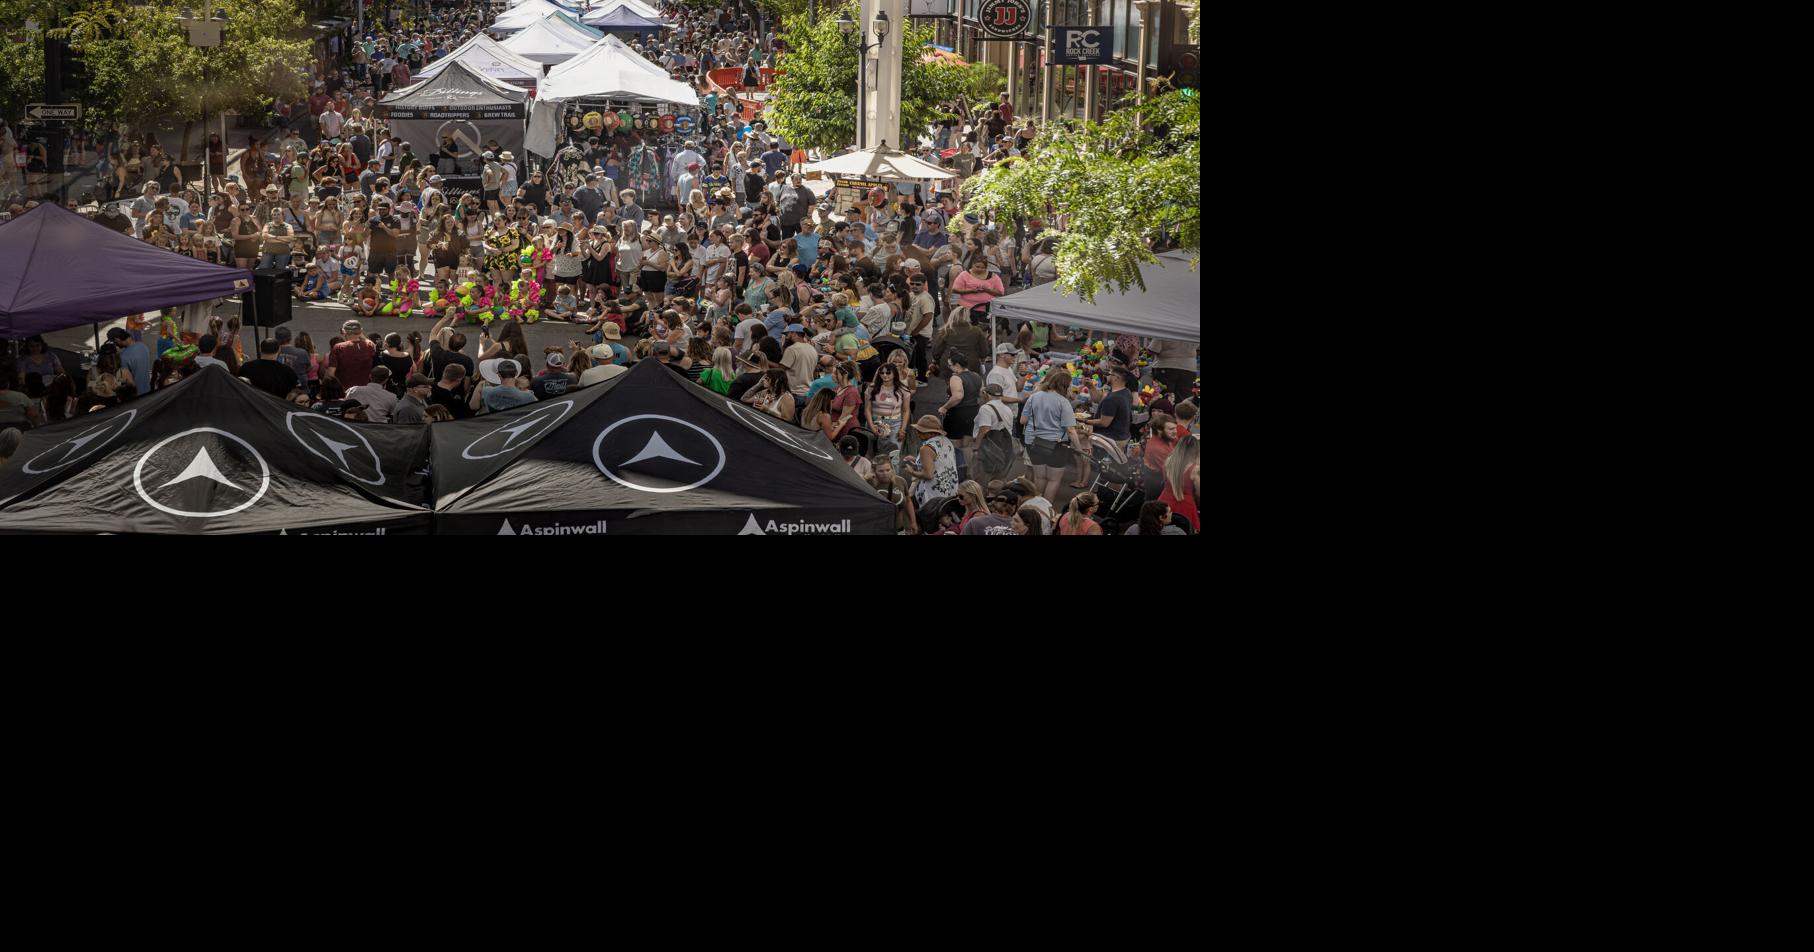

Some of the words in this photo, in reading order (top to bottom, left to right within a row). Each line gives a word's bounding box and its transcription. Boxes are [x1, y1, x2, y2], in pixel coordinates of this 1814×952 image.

[994, 7, 1017, 25] JJ
[1066, 30, 1101, 48] RC
[520, 520, 607, 535] Aspinwall
[764, 519, 851, 535] Aspinwall
